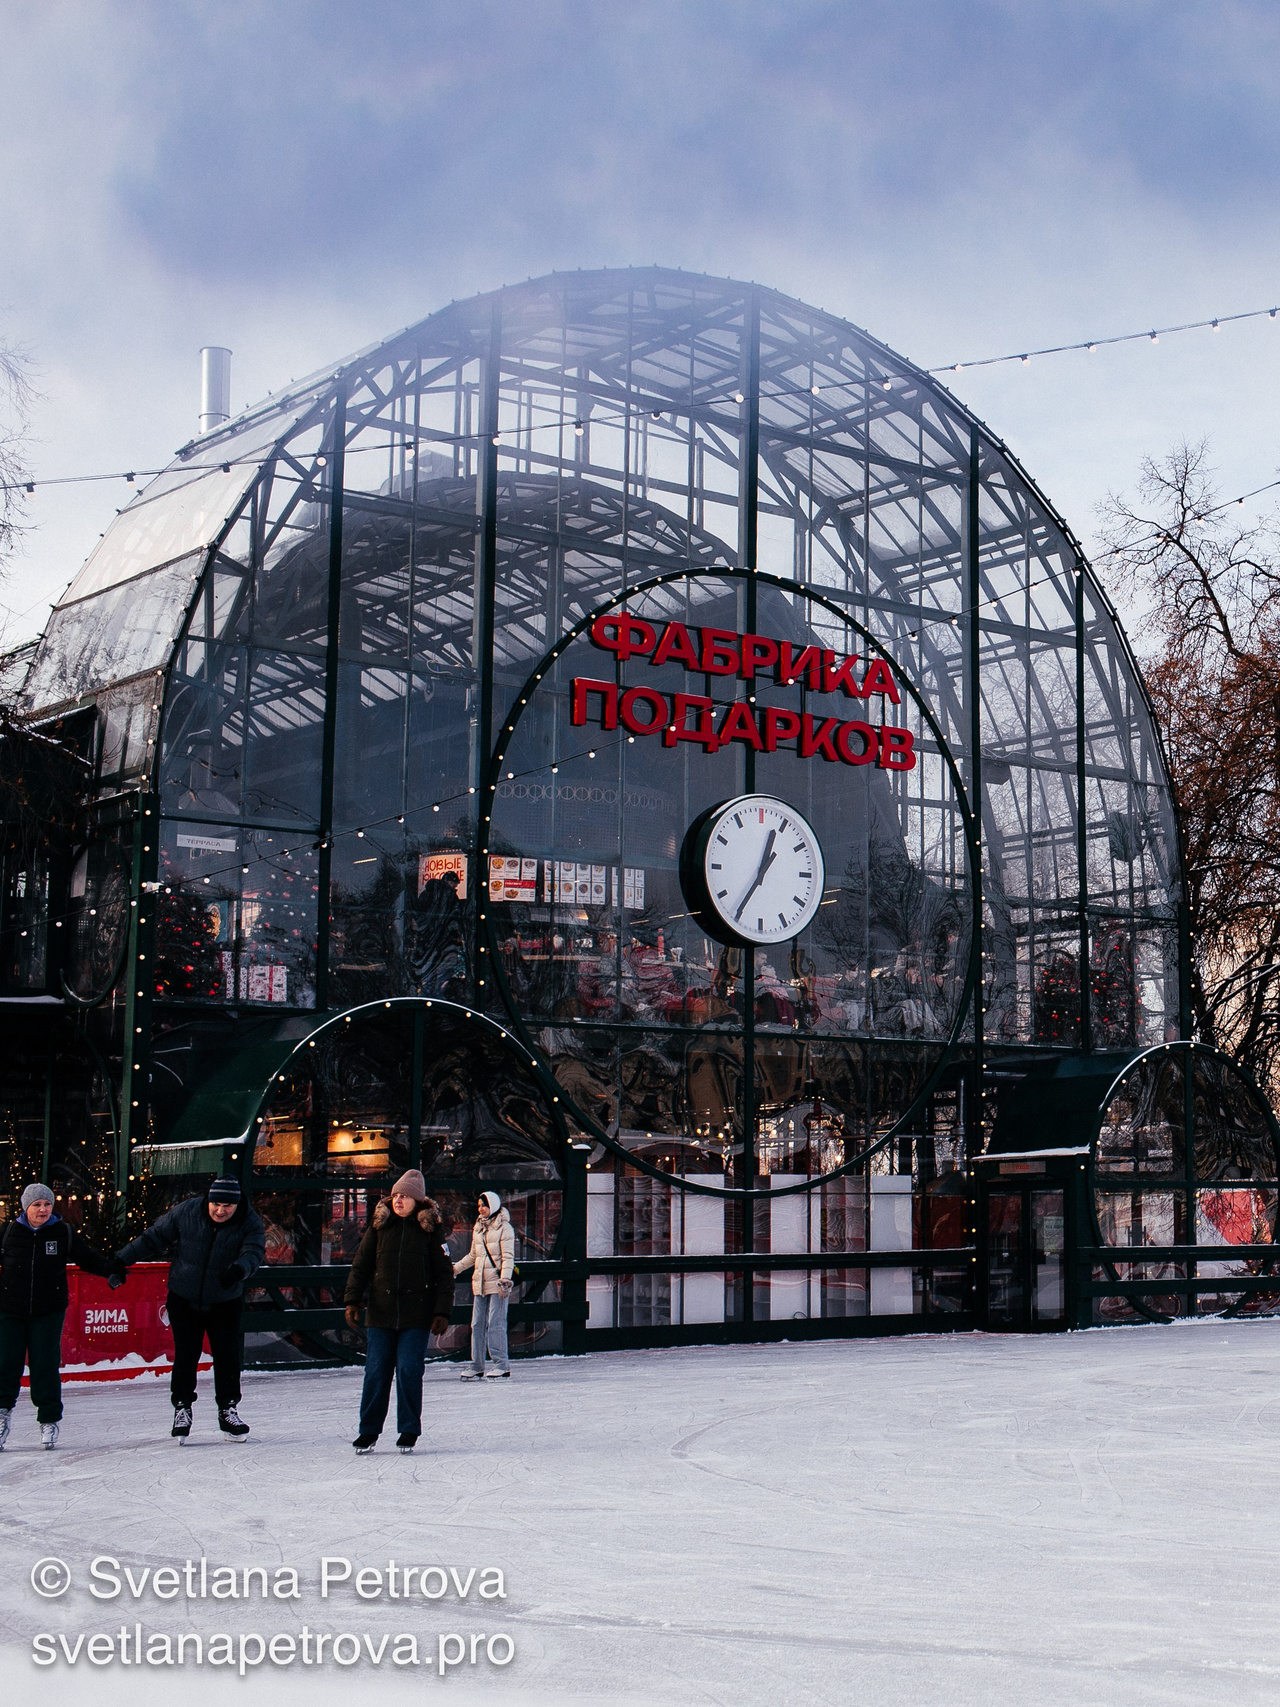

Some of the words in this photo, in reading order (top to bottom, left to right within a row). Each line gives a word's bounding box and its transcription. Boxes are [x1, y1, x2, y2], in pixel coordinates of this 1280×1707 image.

[592, 611, 901, 704] ФАБРИКА
[571, 677, 917, 771] ПОДАРКОВ
[425, 858, 461, 872] НОВЫЕ
[85, 1309, 128, 1324] ЗИМА
[93, 1325, 128, 1333] МОСКВЕ
